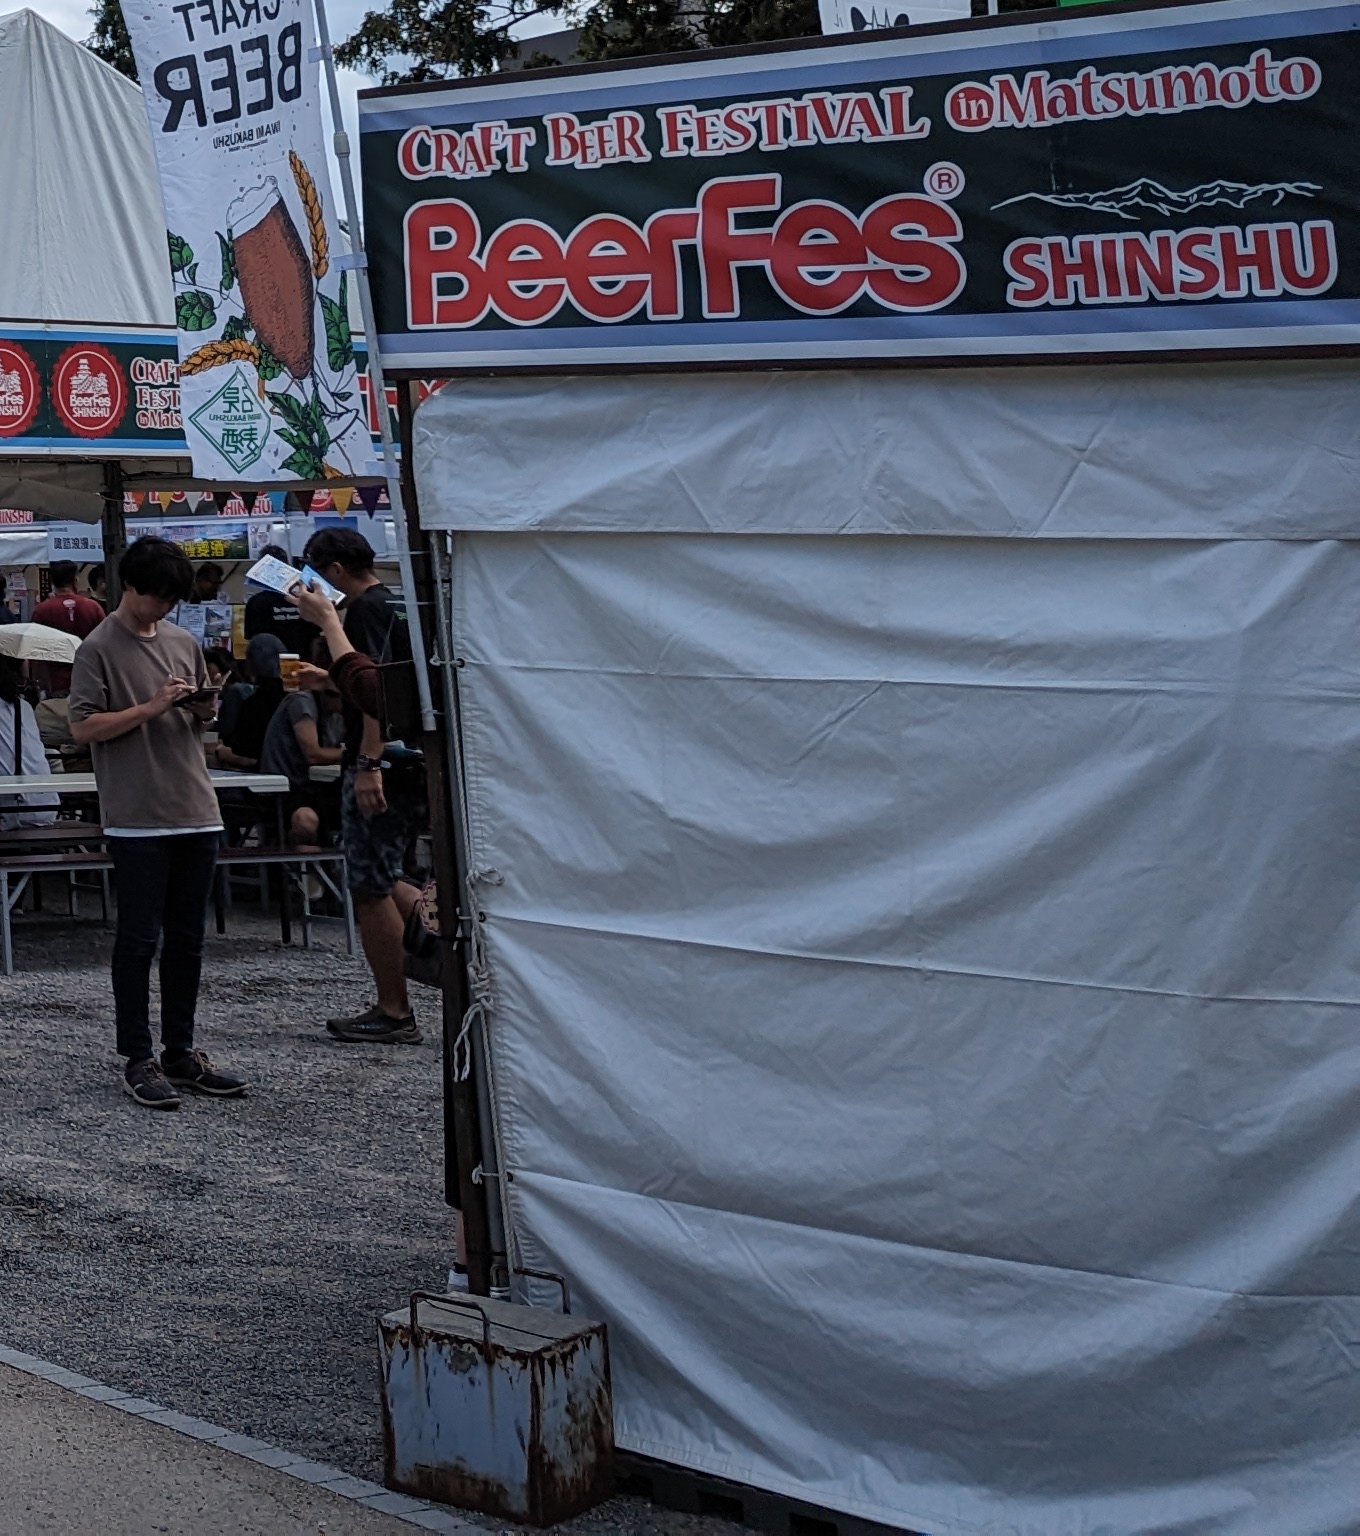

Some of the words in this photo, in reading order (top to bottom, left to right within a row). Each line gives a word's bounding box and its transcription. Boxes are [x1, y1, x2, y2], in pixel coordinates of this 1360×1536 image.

[398, 120, 536, 180] CRAFT
[544, 111, 651, 169] BEER
[657, 86, 931, 157] FESTIVAL
[1002, 220, 1338, 306] SHINSHU
[69, 394, 112, 407] BeerFes
[135, 386, 181, 410] FEST
[72, 407, 110, 418] SHINSHU
